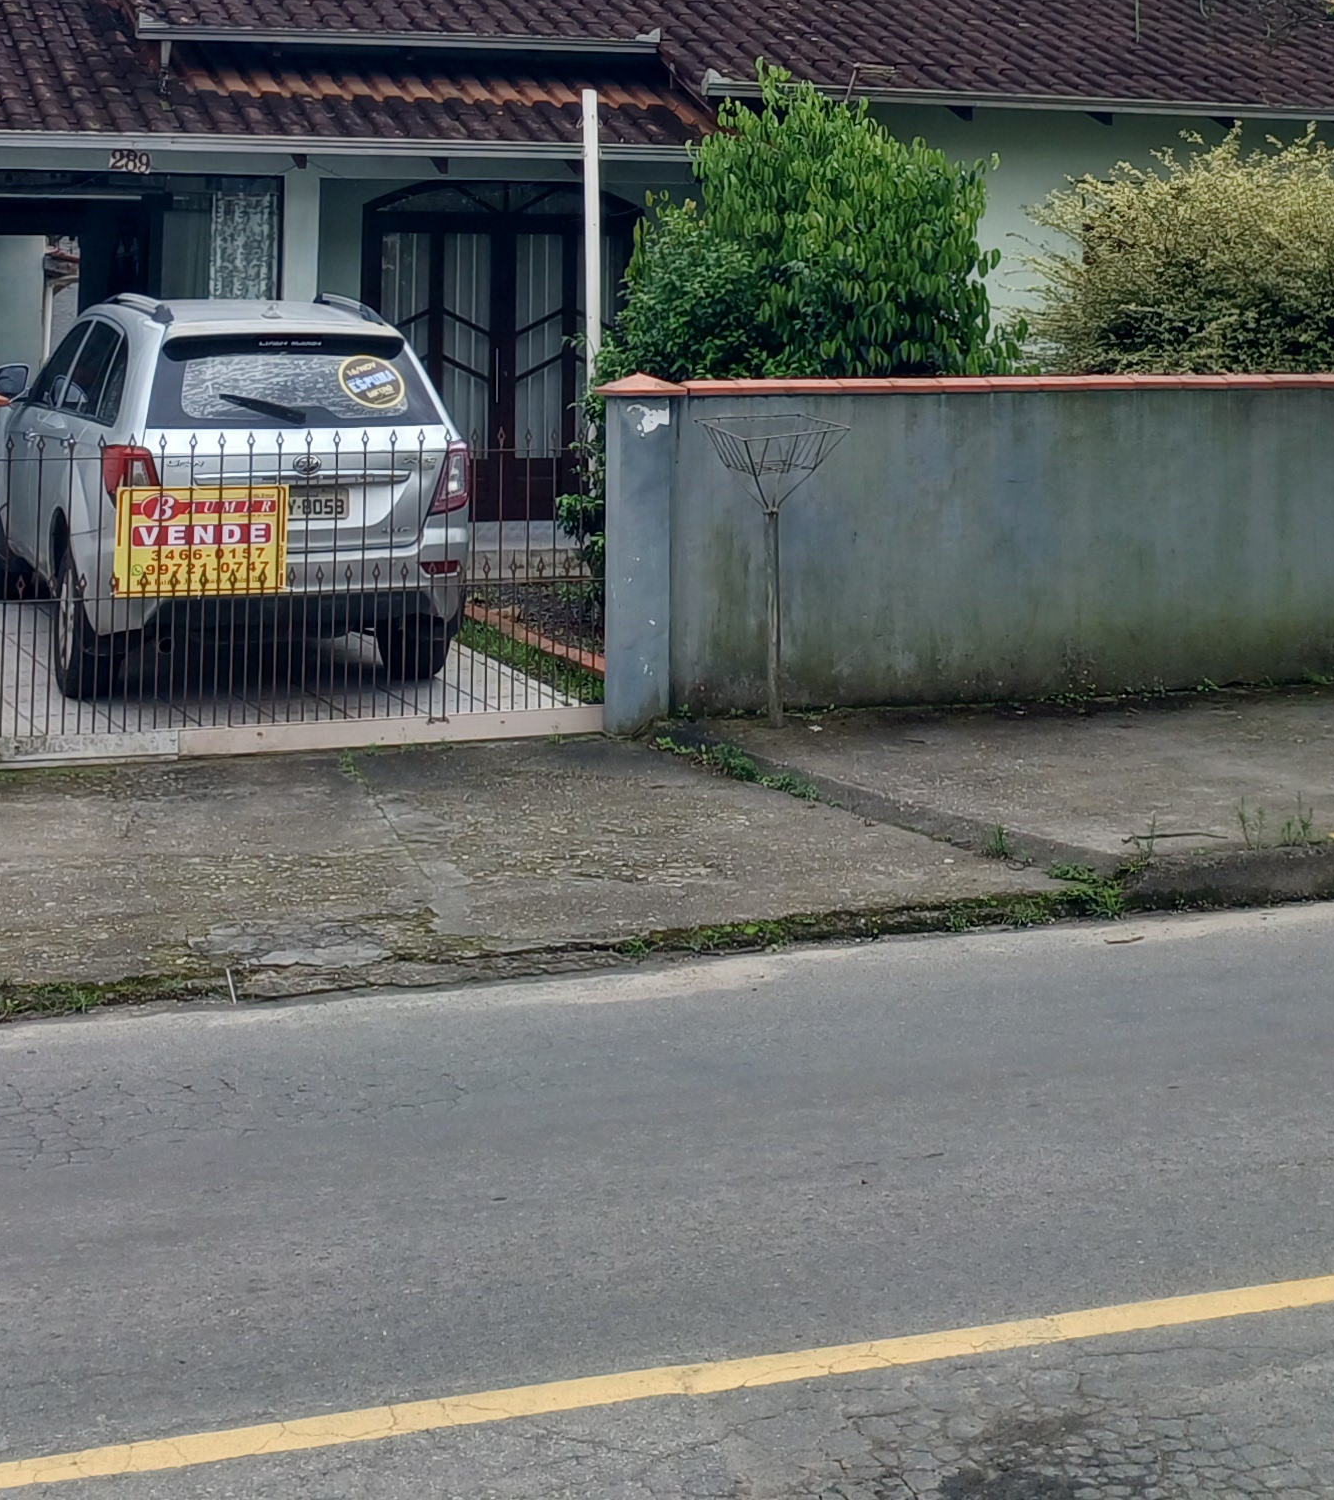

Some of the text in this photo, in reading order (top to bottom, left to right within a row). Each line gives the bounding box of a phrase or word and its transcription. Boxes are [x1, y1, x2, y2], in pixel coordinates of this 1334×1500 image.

[109, 149, 151, 172] 289
[139, 525, 267, 545] VENDE
[151, 547, 265, 561] 3466-0157
[145, 561, 269, 575] 99721-0747
